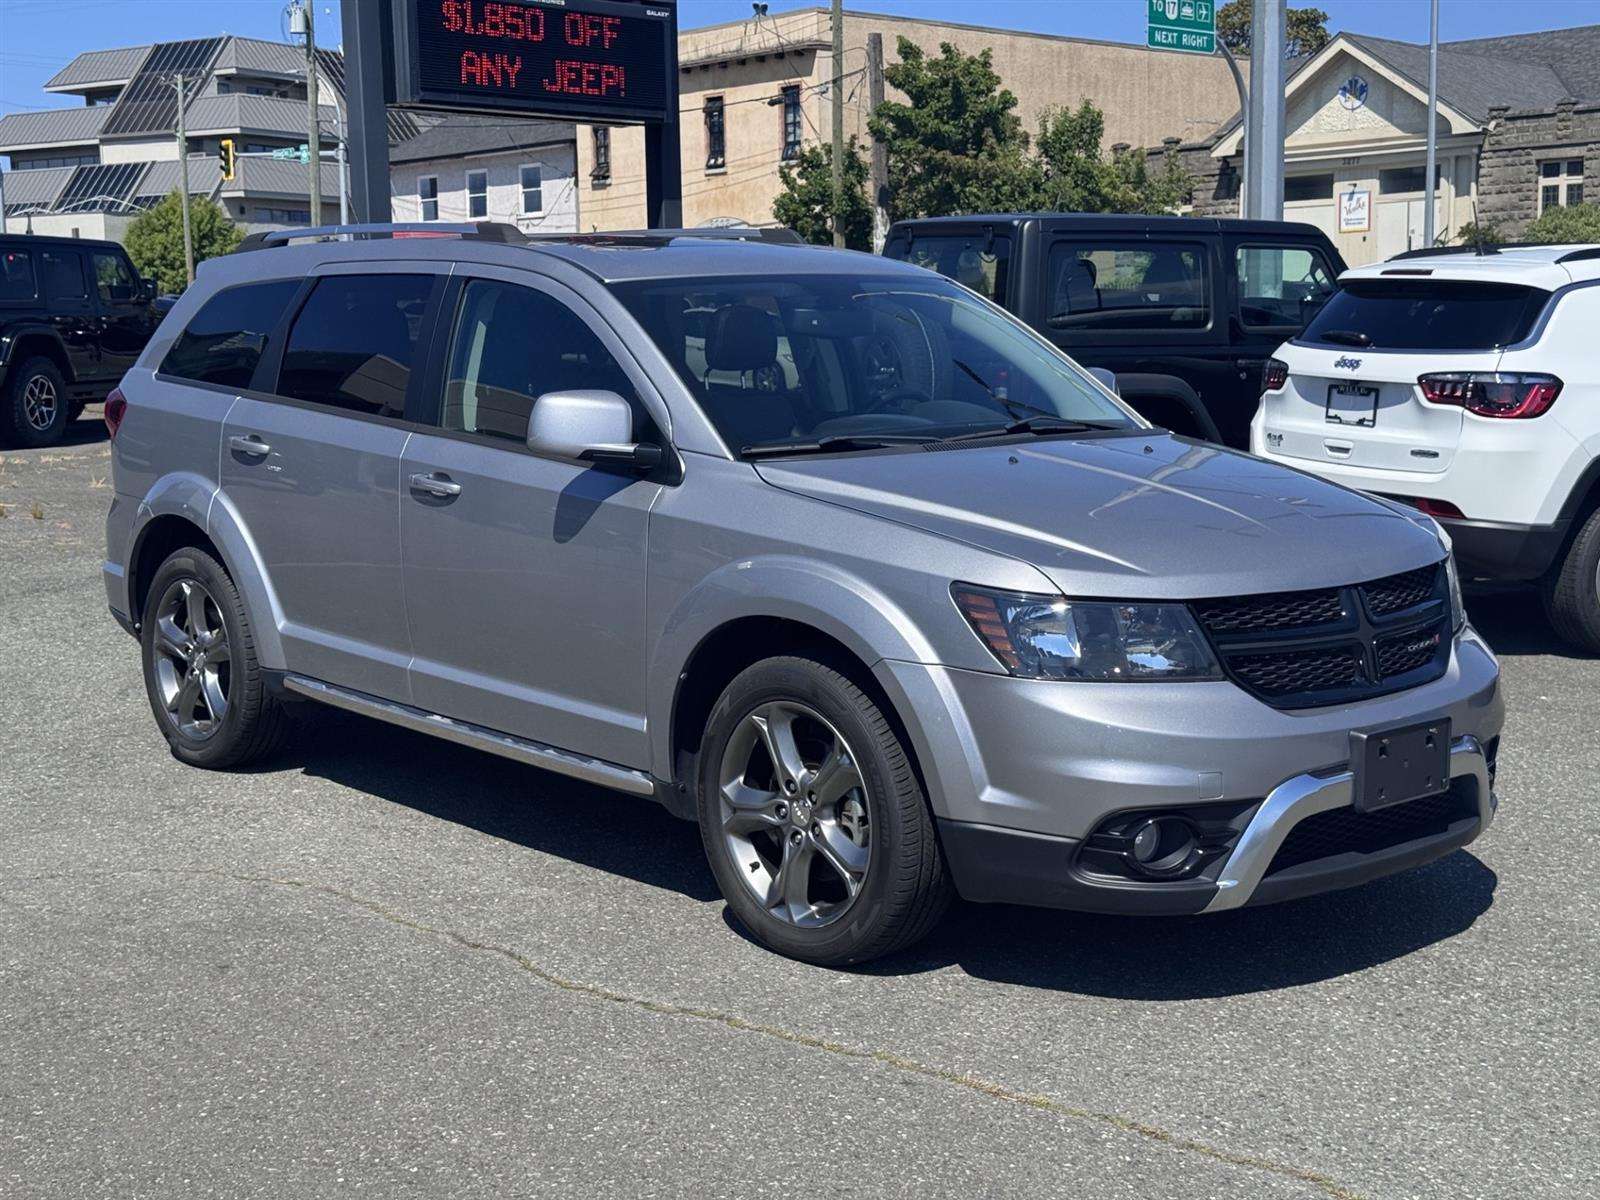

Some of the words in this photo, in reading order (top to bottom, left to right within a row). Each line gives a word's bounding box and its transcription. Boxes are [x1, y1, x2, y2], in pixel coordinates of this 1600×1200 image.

[1152, 0, 1164, 12] TO
[442, 0, 545, 42] $1,850
[565, 12, 621, 48] OFF
[1154, 30, 1178, 44] NEXT
[1182, 33, 1208, 48] RIGHT
[460, 50, 522, 88] ANY
[542, 60, 625, 97] JEEP!
